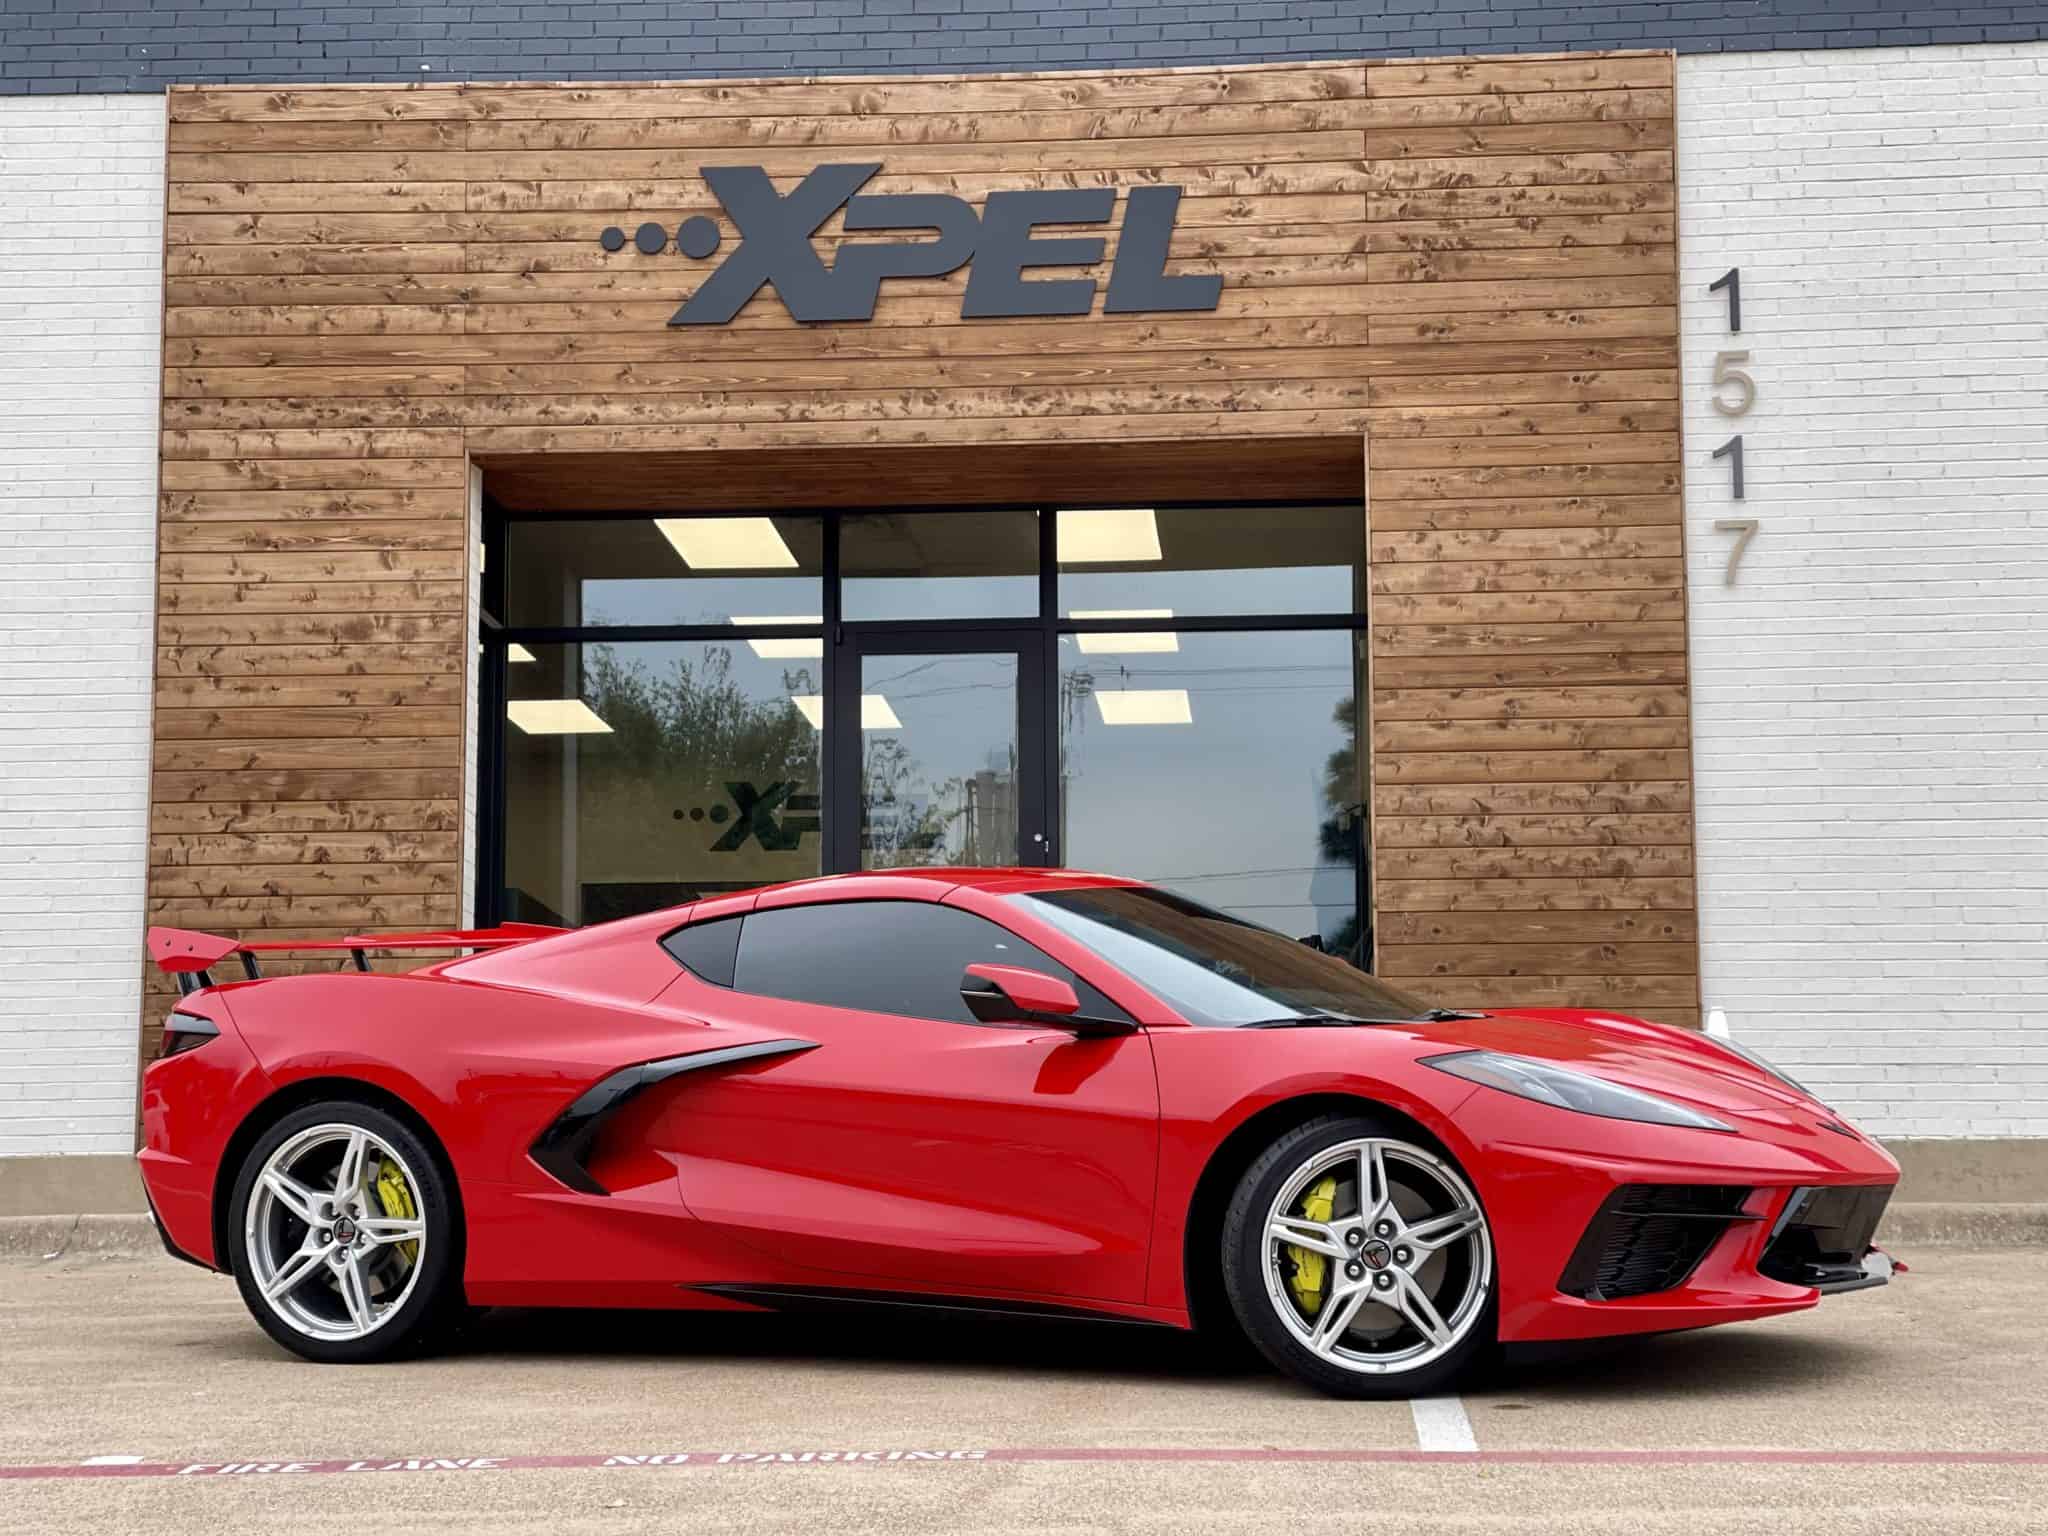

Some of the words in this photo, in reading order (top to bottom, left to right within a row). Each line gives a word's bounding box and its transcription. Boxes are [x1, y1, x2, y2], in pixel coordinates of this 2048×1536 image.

[667, 162, 1223, 326] XPEL
[1709, 267, 1758, 588] 1517
[178, 1462, 322, 1474] FIRE
[344, 1457, 511, 1472] LANE
[603, 1454, 690, 1466] NO
[716, 1450, 986, 1464] PARKING
